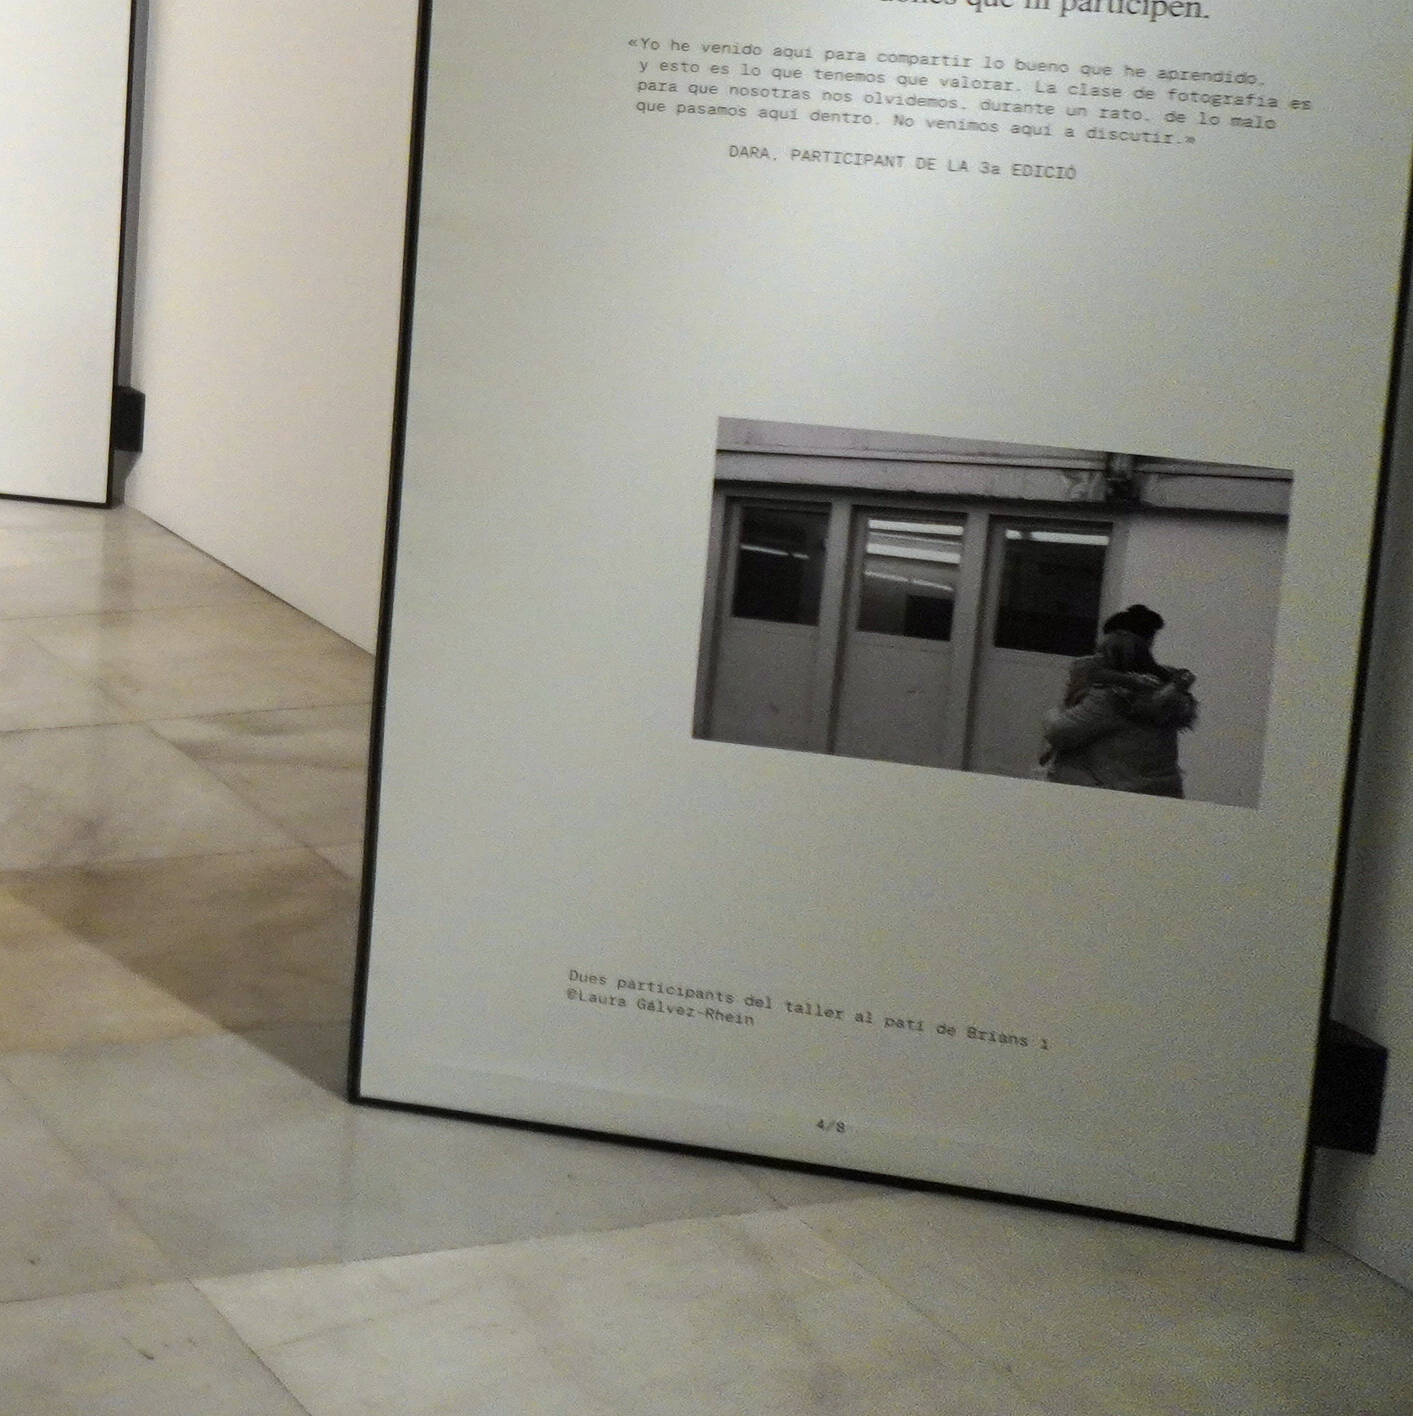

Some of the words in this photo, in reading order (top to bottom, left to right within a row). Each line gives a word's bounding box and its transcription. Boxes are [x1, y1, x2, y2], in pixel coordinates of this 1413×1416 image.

[728, 144, 777, 161] DARA,
[790, 148, 905, 168] PARTICIPANT
[915, 156, 937, 171] DE
[947, 159, 969, 172] LA
[979, 161, 1001, 175] 3a
[1011, 162, 1077, 180] EDICIÓ
[815, 1118, 846, 1134] 4/8
